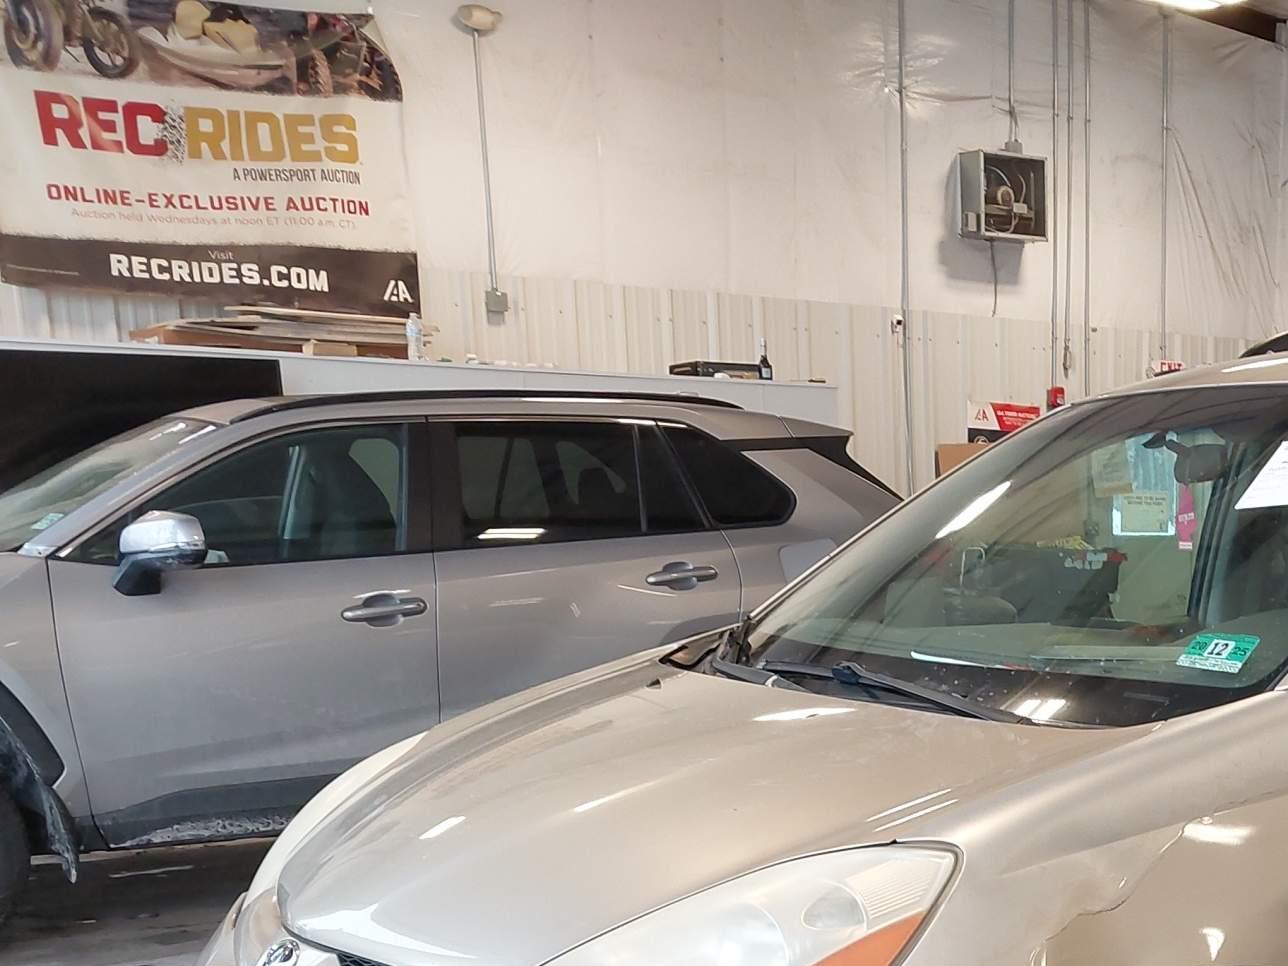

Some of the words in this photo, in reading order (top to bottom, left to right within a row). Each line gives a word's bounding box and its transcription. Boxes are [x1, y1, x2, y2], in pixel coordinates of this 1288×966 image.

[34, 90, 169, 156] REC
[184, 106, 359, 164] RIDES
[233, 168, 241, 181] A
[244, 168, 317, 182] POWERSPORT
[321, 169, 361, 184] AUCTION
[47, 183, 276, 211] ONLINE-EXCLUSIVE
[286, 196, 369, 216] AUCTION
[72, 208, 116, 219] Auction
[119, 212, 143, 222] held
[147, 214, 218, 227] Wednesdays
[220, 217, 231, 225] at
[235, 217, 263, 226] noon
[267, 217, 280, 226] ET
[208, 249, 233, 260] Visit
[109, 253, 329, 292] RECRIDES.COM
[1207, 642, 1229, 656] 12
[1231, 646, 1250, 657] 25
